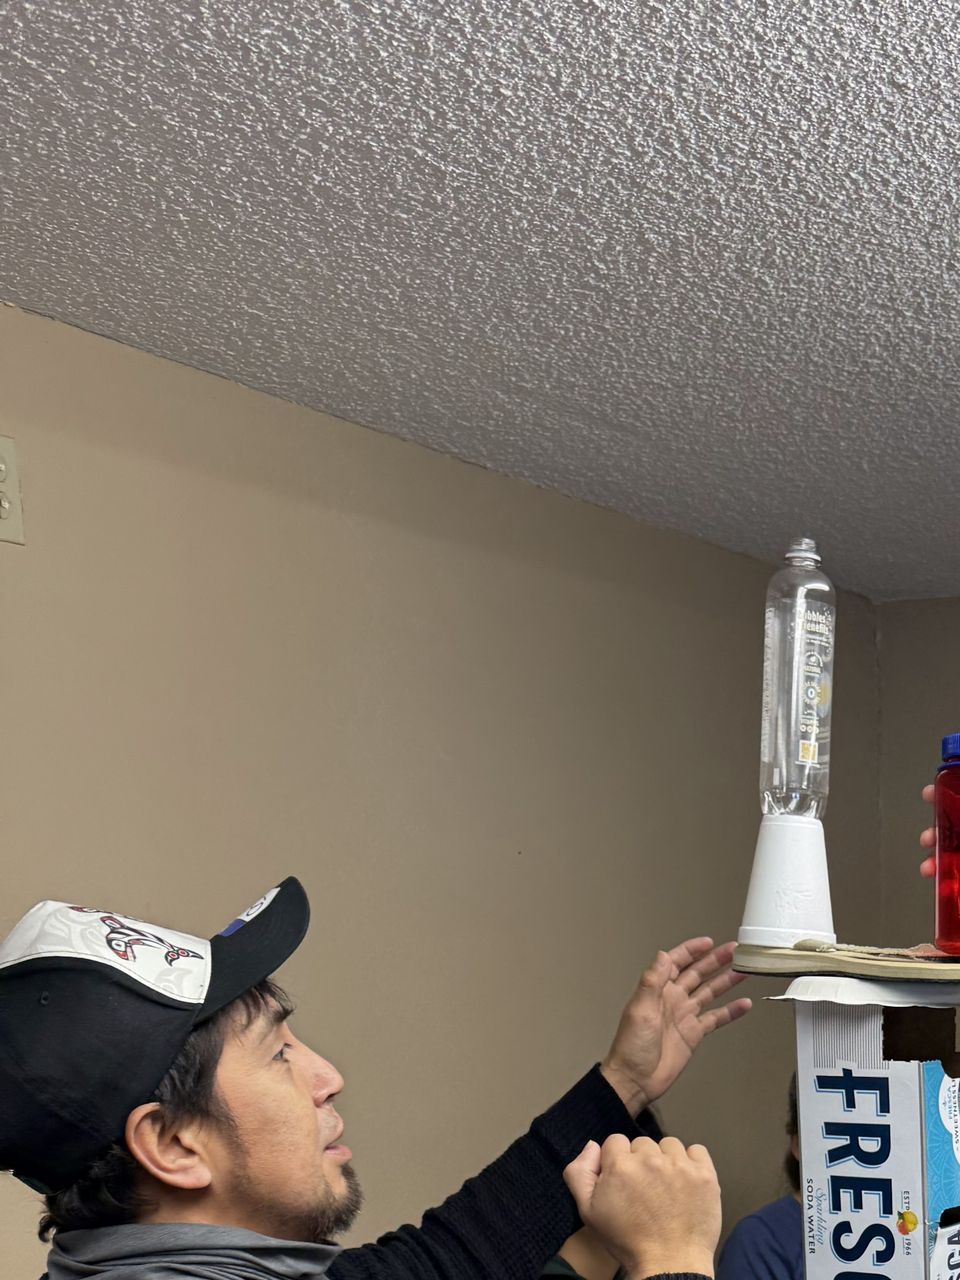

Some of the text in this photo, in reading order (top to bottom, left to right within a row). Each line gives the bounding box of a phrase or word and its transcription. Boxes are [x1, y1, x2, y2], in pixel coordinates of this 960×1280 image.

[951, 1089, 960, 1145] SWEETNESS
[806, 1178, 816, 1254] SODA WATER
[814, 1187, 828, 1246] Sparkling
[904, 1237, 912, 1256] 1966
